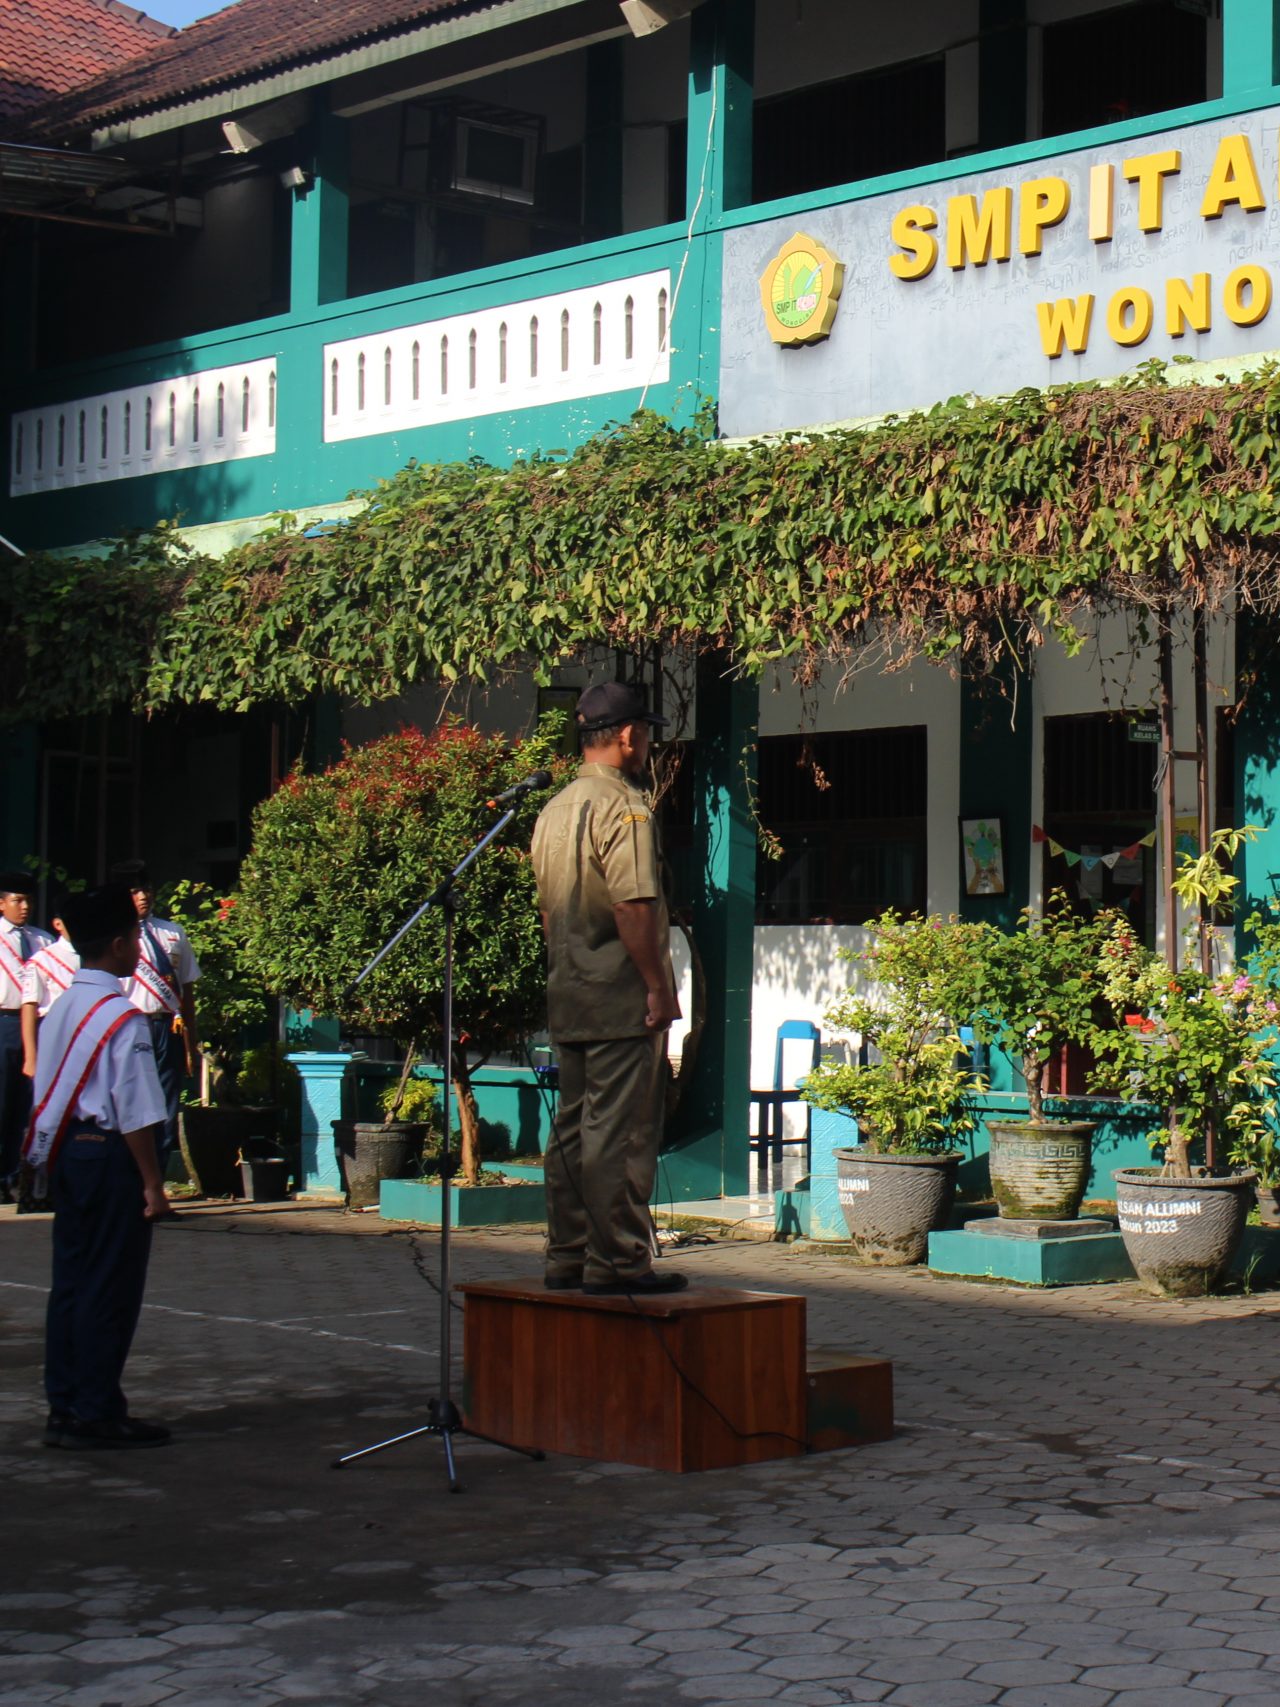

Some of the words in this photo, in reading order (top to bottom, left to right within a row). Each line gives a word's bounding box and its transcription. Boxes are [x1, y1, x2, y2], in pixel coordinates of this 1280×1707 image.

[888, 176, 1071, 281] SMP
[1089, 150, 1182, 244] IT
[777, 302, 790, 314] SMP
[1145, 1220, 1177, 1234] 2023
